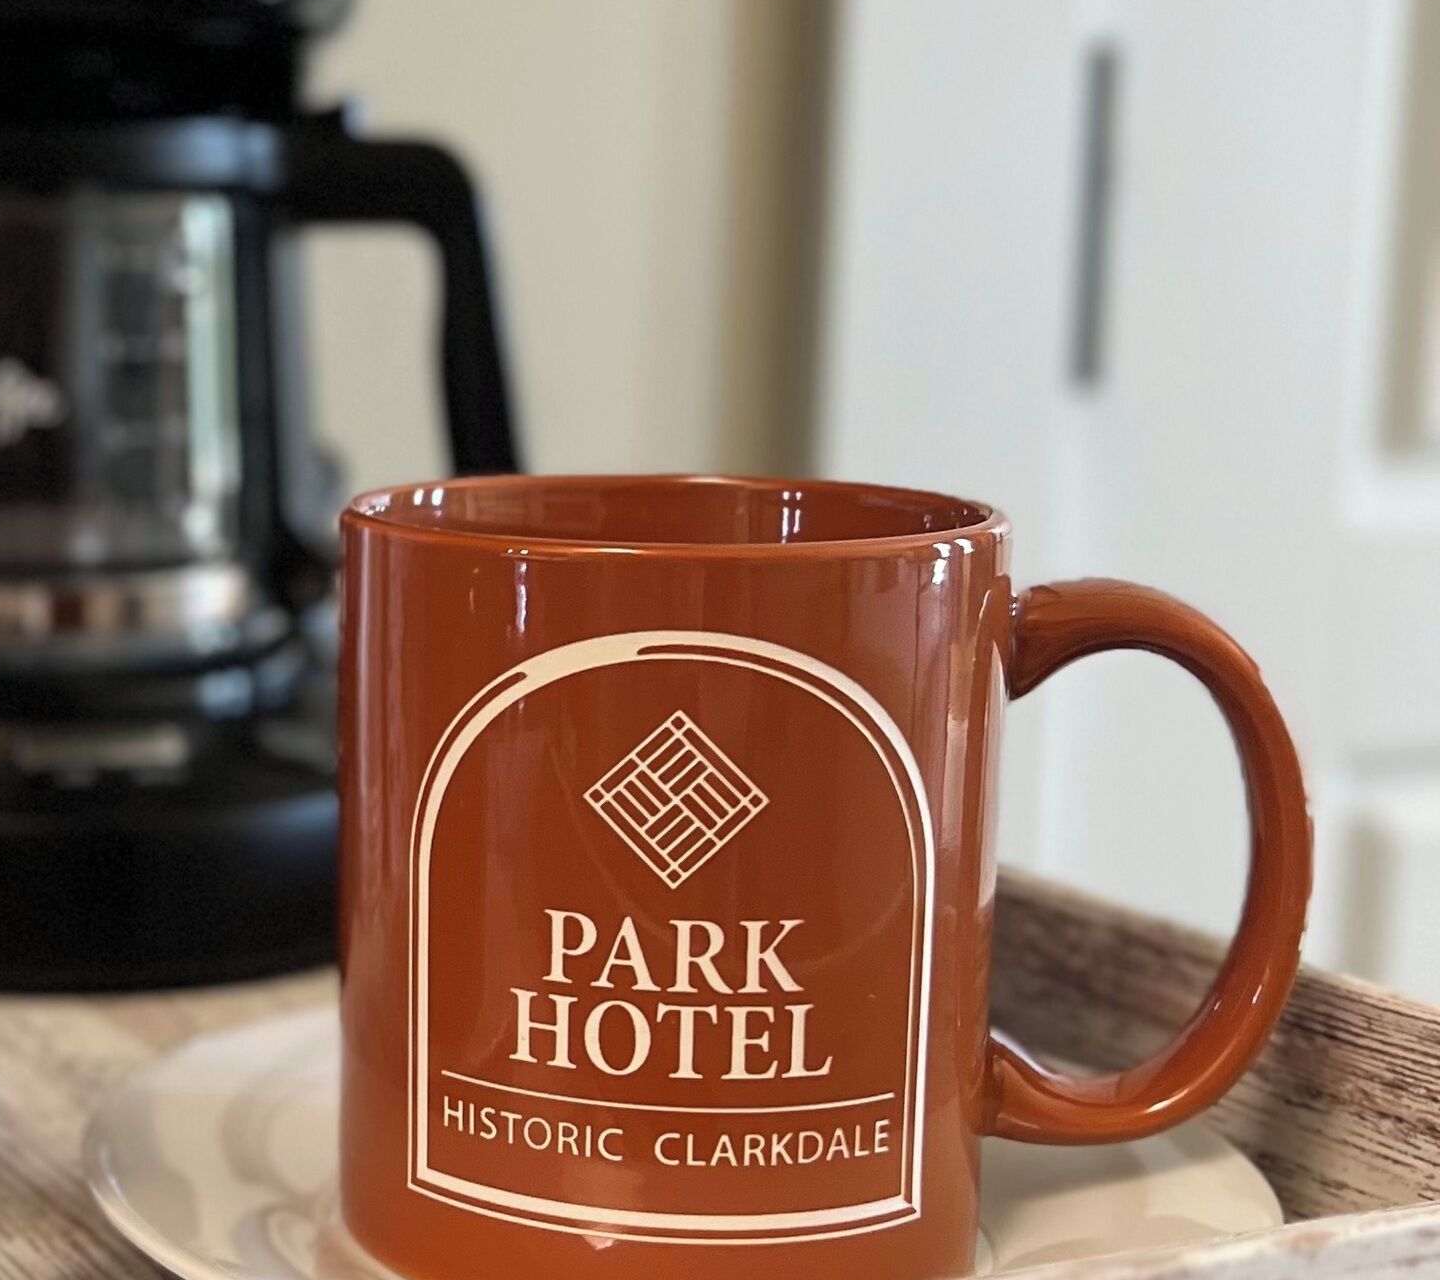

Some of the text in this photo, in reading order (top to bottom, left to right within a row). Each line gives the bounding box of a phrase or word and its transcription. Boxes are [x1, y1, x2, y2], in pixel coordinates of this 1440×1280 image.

[542, 908, 805, 995] PARK
[508, 987, 833, 1081] HOTEL
[443, 1095, 891, 1168] HISTORIC CLARKDALE
